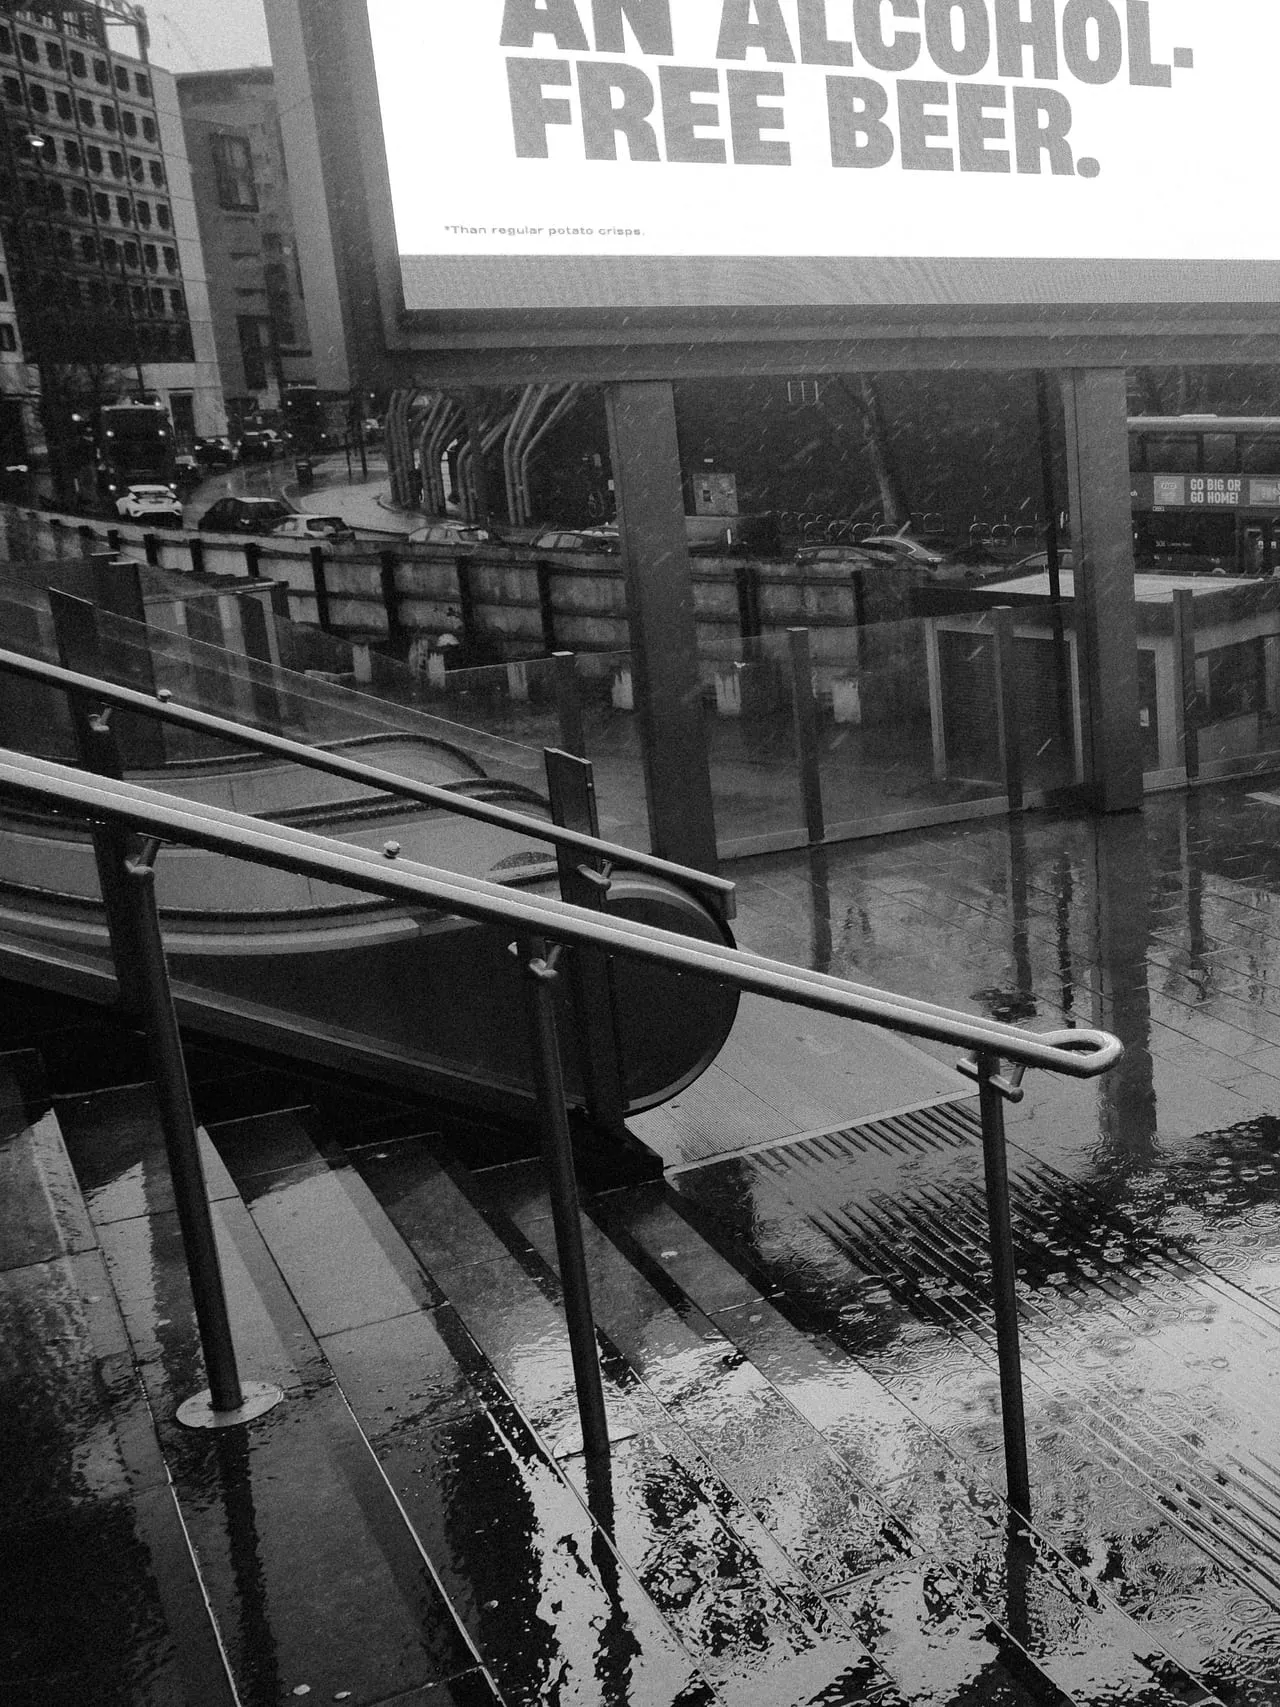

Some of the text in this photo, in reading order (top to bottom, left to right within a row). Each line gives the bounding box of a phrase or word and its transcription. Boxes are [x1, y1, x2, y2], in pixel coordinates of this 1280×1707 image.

[716, 0, 1194, 88] ALCOHOL-
[505, 57, 1101, 178] FREE BEER.
[491, 225, 545, 237] regular
[548, 225, 594, 237] potato
[598, 226, 646, 238] crisps.
[1190, 478, 1204, 491] GO
[1207, 478, 1224, 491] BIG
[1227, 479, 1241, 492] OR
[1190, 491, 1239, 505] GO HOME!
